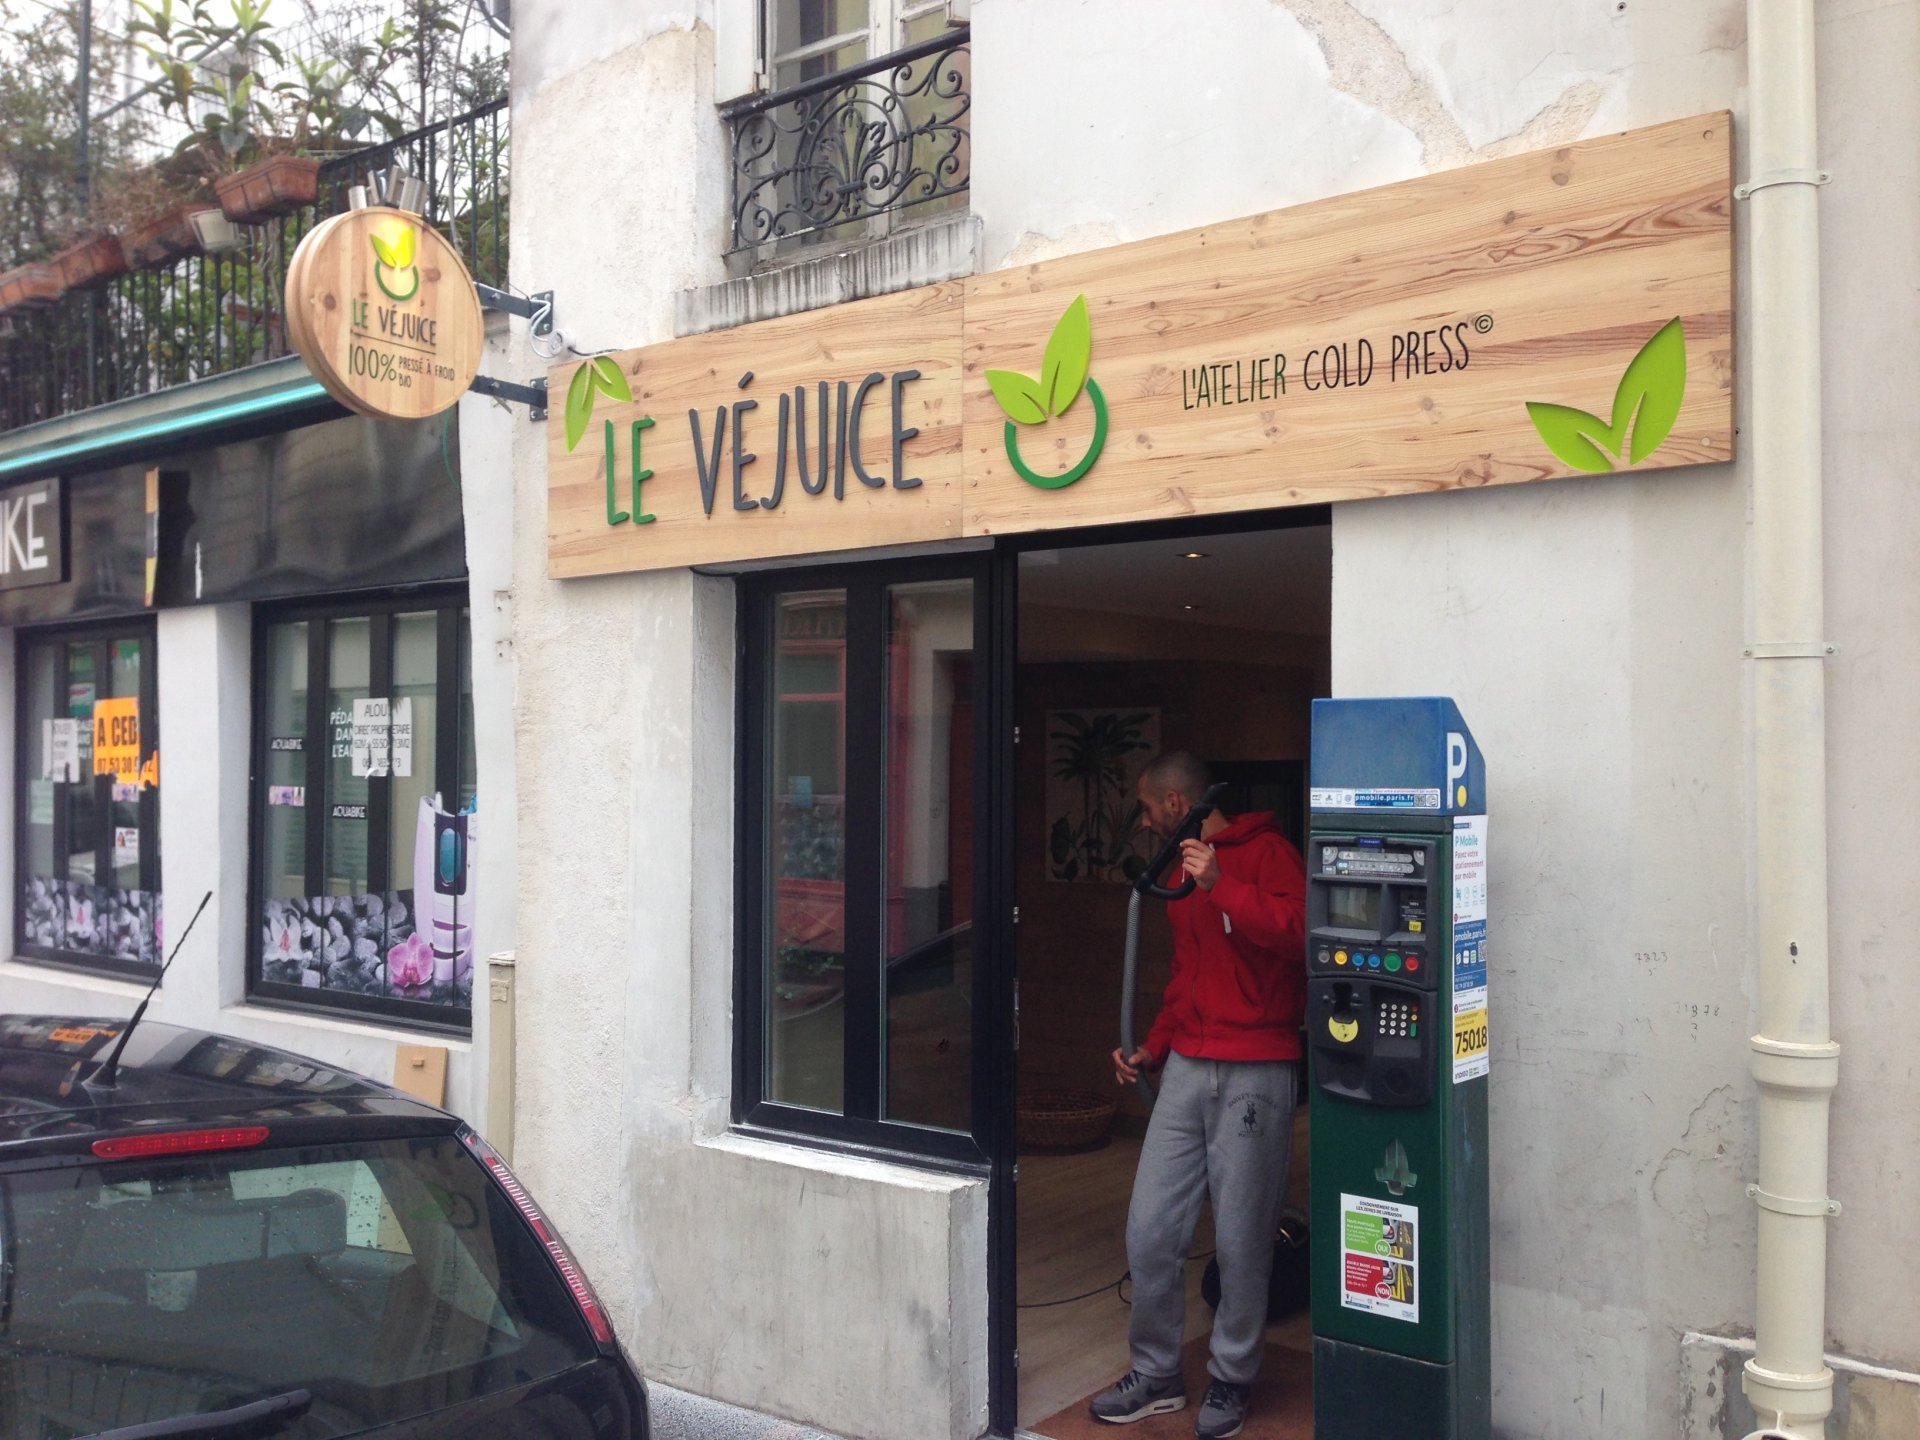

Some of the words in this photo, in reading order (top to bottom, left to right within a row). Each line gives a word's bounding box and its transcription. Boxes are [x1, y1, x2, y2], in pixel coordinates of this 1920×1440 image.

[353, 298, 368, 329] LE
[378, 305, 437, 347] VÉJUICE
[348, 343, 396, 382] 100%
[398, 353, 424, 373] PRESSÉ
[427, 358, 432, 376] À
[435, 365, 455, 381] FROID
[1183, 353, 1286, 410] L'ATELIER
[1303, 338, 1373, 391] COLD
[399, 373, 411, 388] BIO
[605, 417, 656, 526] LE
[688, 370, 923, 515] VÉJUICE
[97, 717, 106, 747] A
[1447, 732, 1468, 809] P
[1355, 793, 1413, 802] pmobile.paris.fr
[1460, 835, 1478, 846] Mobile
[1455, 1026, 1487, 1055] 75018
[1377, 1287, 1390, 1296] NON
